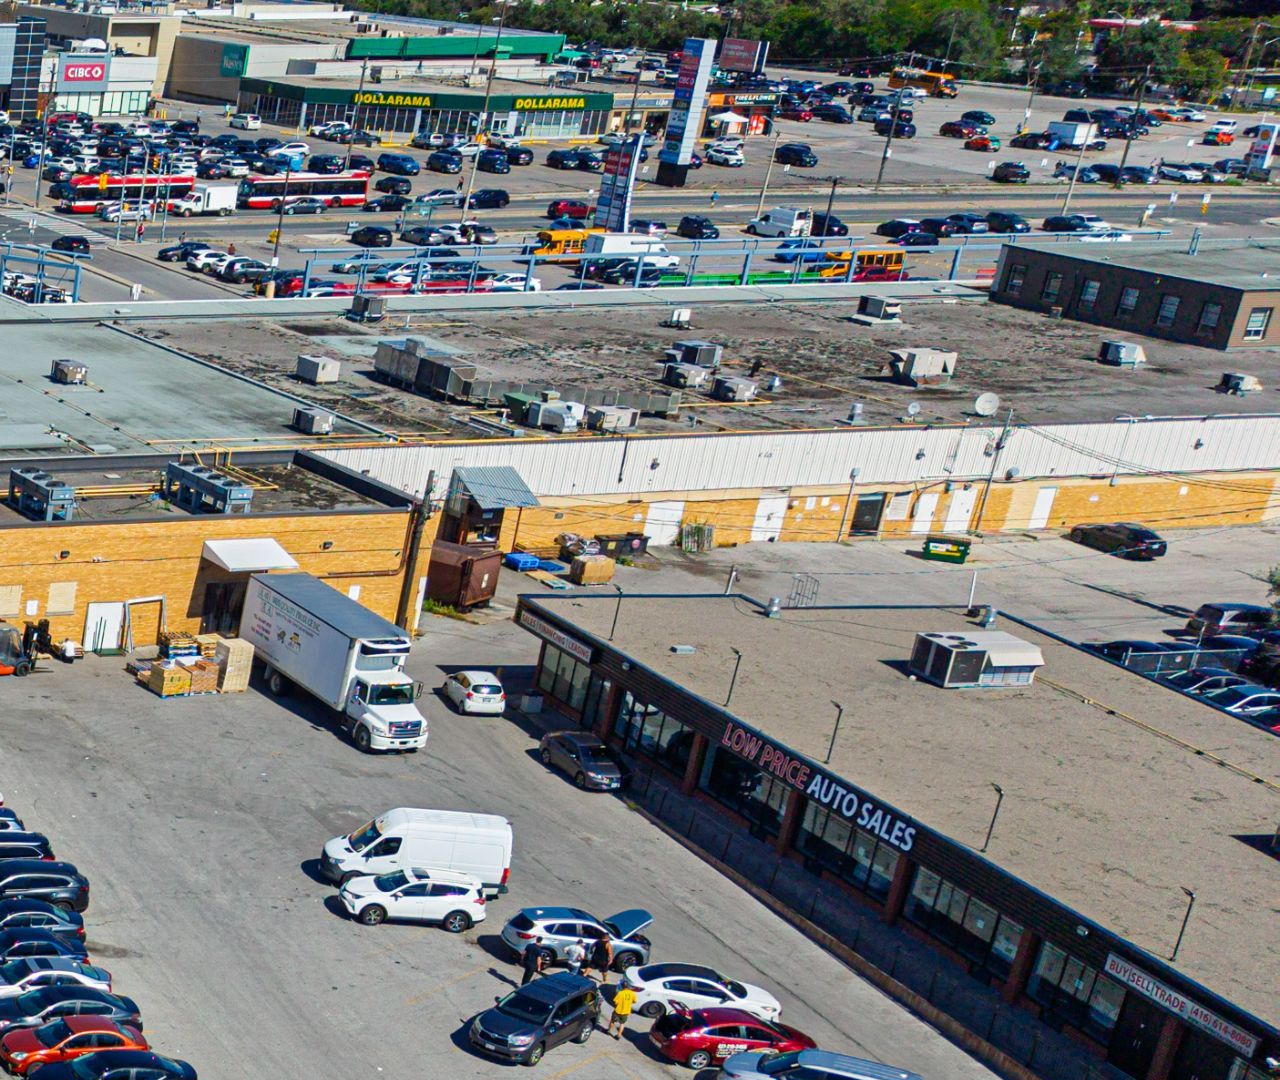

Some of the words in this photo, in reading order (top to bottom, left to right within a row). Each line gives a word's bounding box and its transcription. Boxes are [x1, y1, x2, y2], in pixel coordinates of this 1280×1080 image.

[67, 67, 92, 78] CIBC
[354, 92, 431, 107] DOLLARAMA
[515, 97, 585, 110] DOLLARAMA
[722, 722, 762, 760] LOW
[758, 743, 810, 790] PRICE
[806, 774, 857, 817] AUTO
[856, 802, 916, 851] SALES
